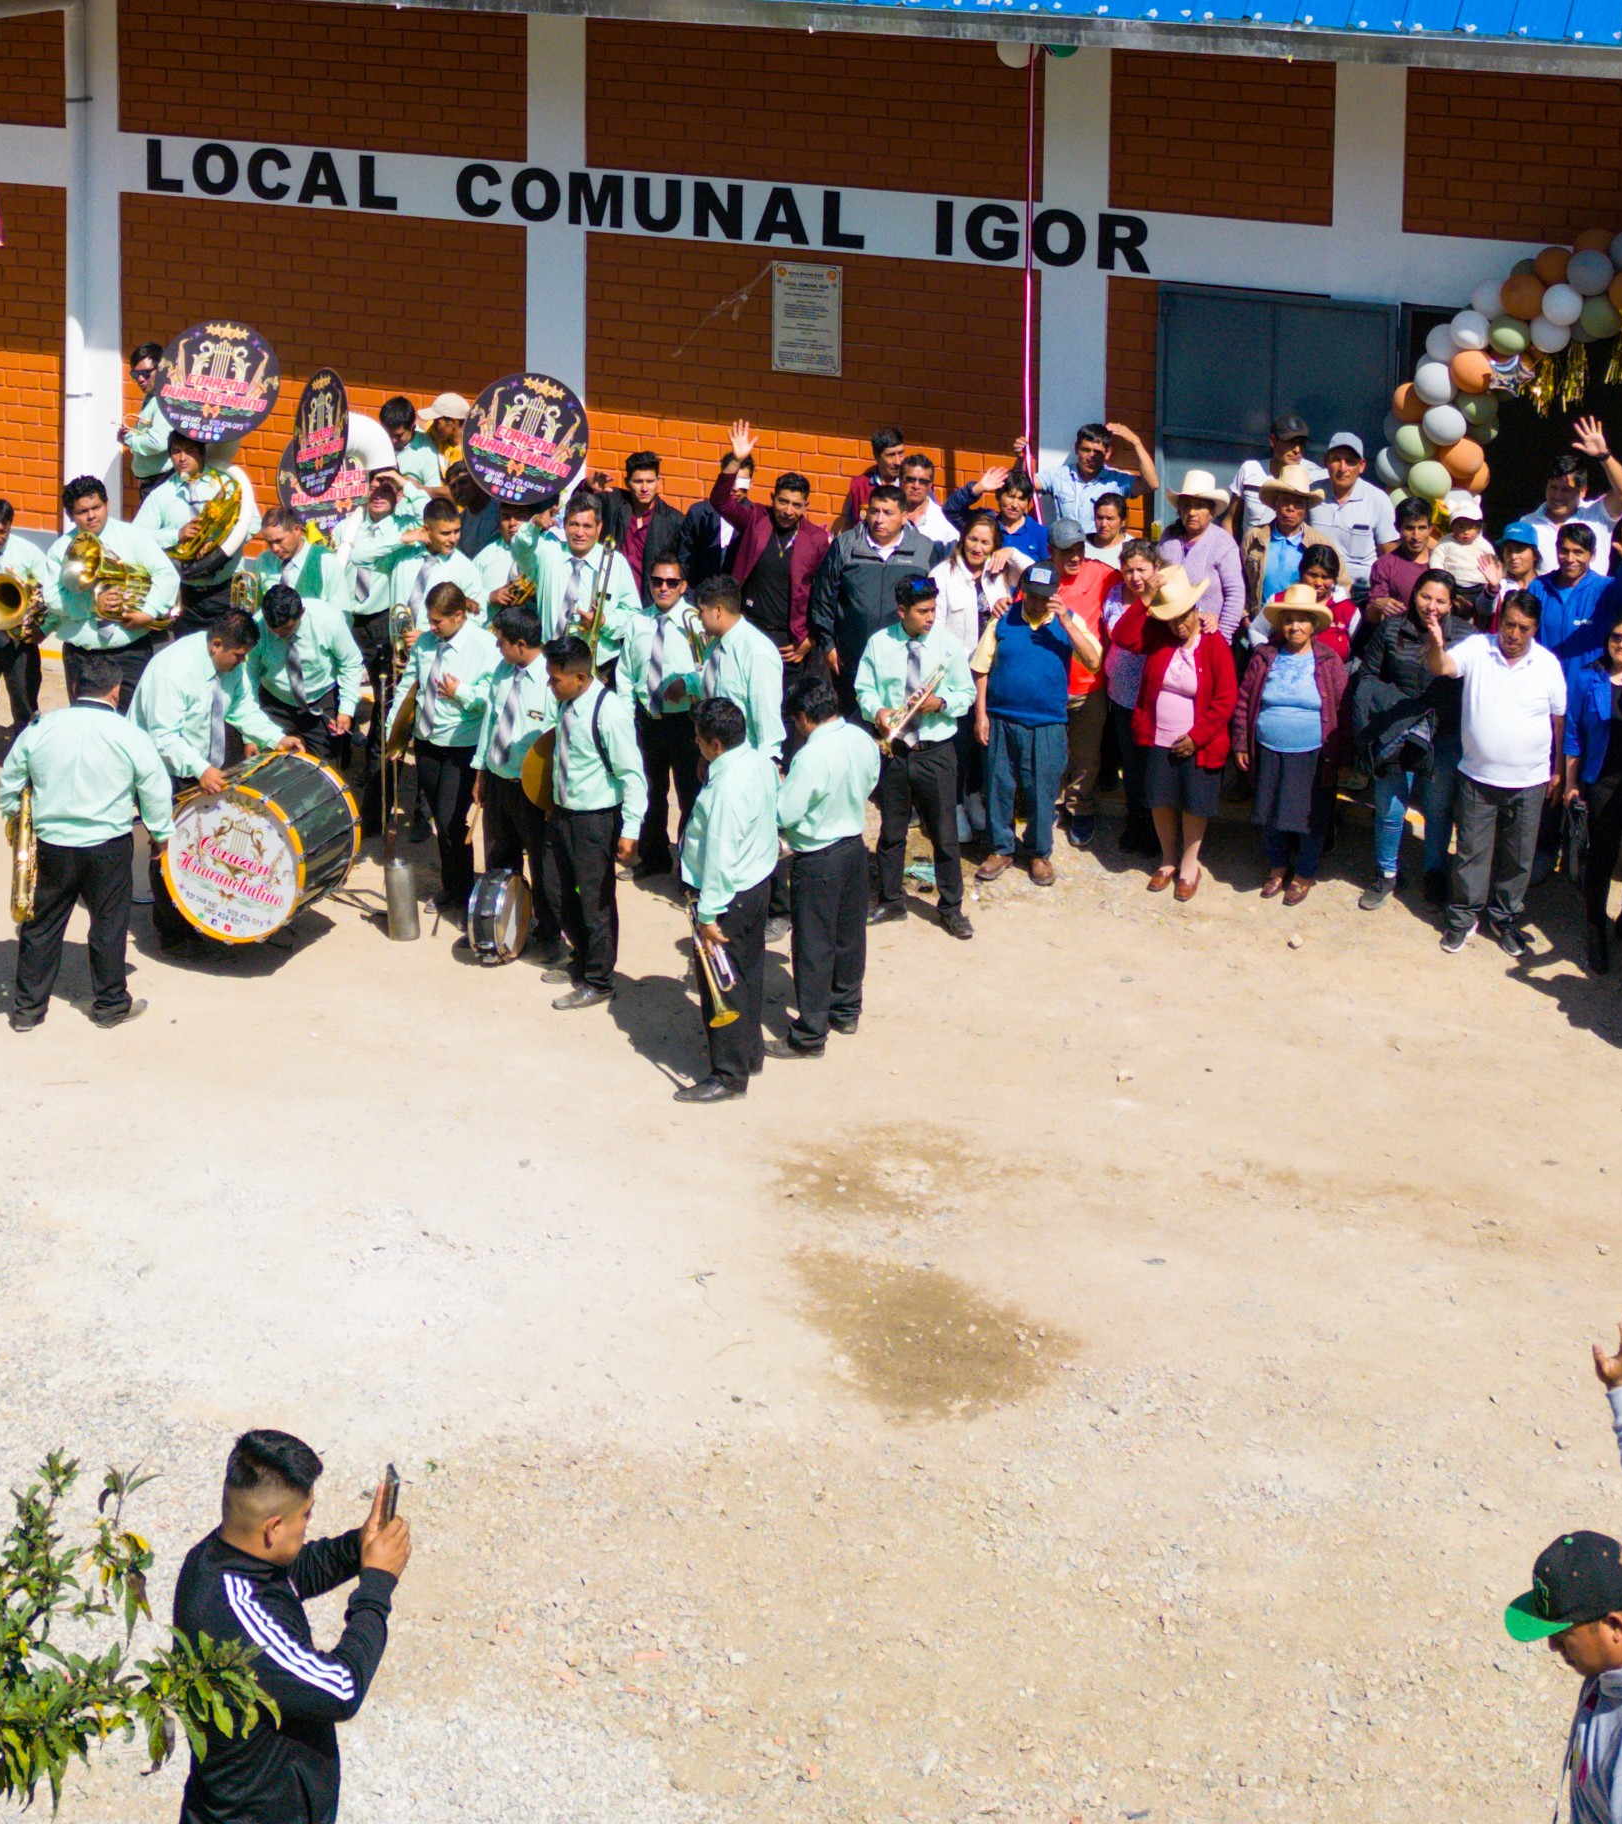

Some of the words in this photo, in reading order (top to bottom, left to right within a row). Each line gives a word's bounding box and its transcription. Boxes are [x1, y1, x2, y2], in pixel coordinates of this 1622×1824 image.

[146, 138, 398, 211] LOCAL
[455, 163, 865, 250] COMUNAL
[935, 199, 1151, 274] IGOR
[161, 384, 267, 412] HUARANCHALINO
[179, 851, 283, 907] Huaranchalino
[200, 836, 270, 876] Corazón
